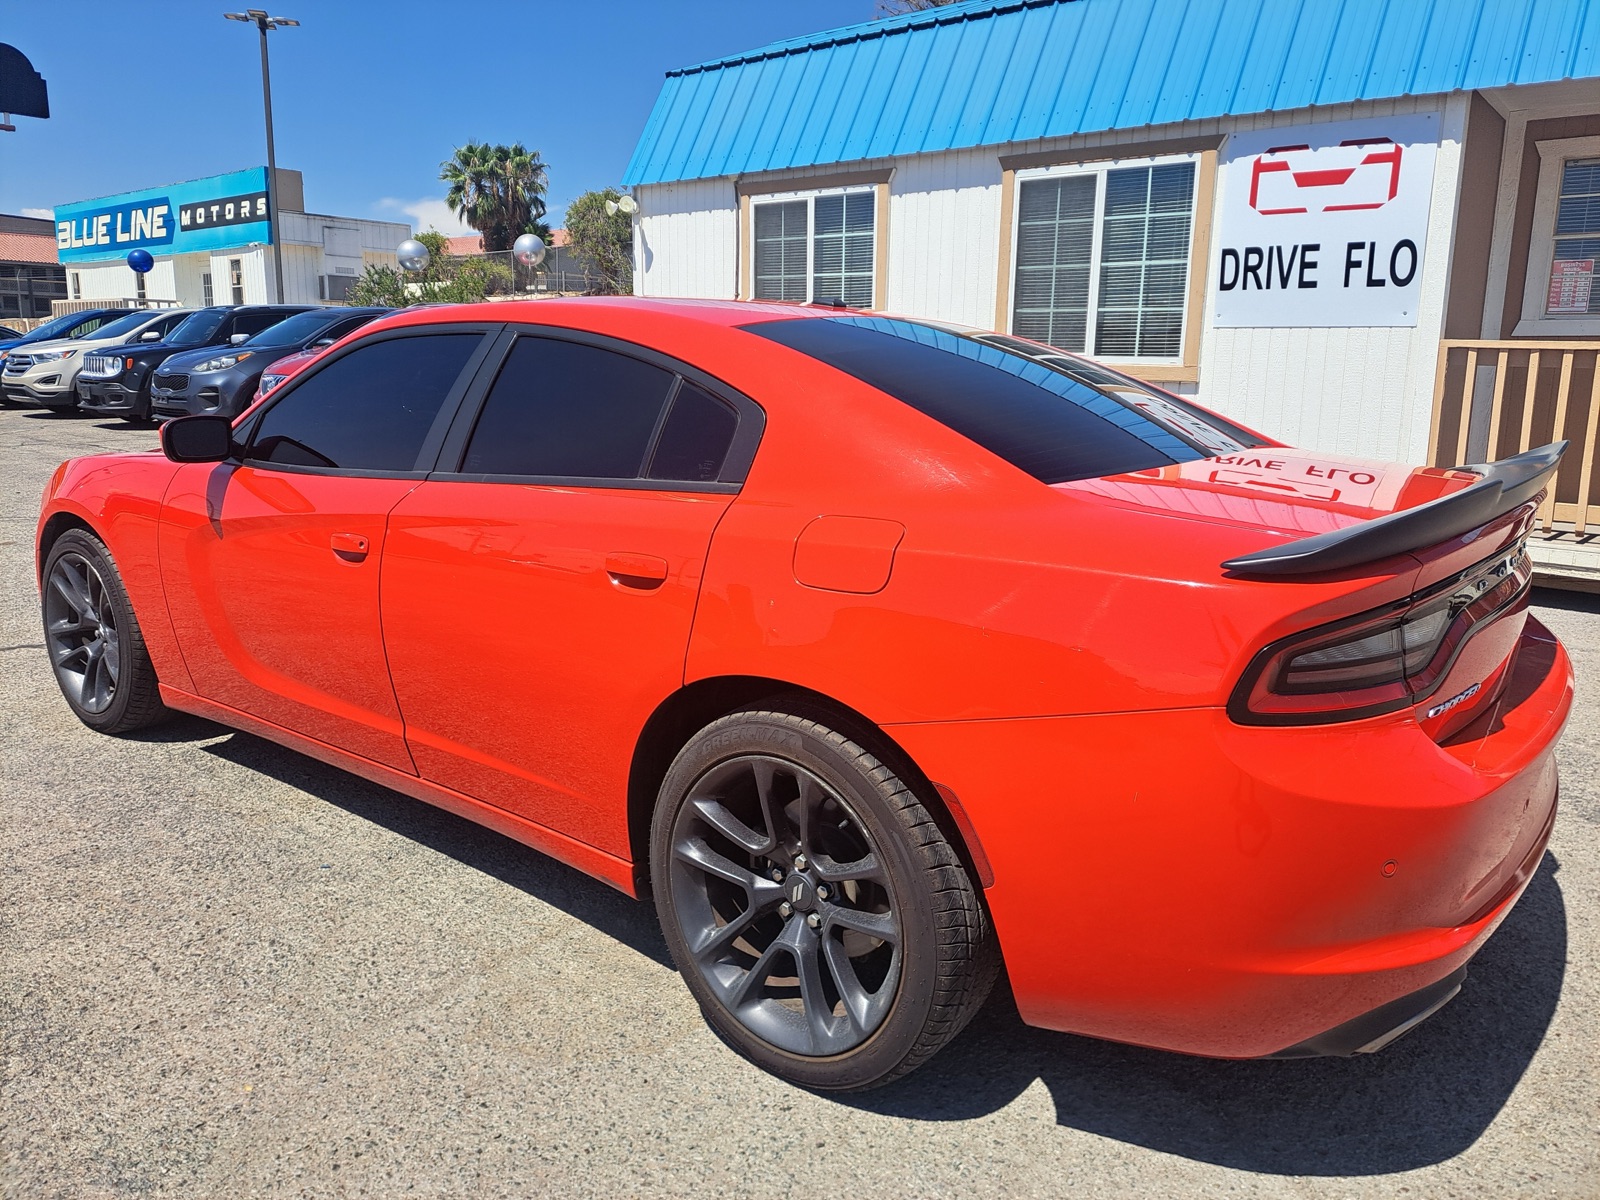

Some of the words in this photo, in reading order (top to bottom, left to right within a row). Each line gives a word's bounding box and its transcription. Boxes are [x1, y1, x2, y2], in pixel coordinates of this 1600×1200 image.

[58, 214, 110, 249] BLUE
[116, 205, 169, 243] LINE
[181, 197, 266, 226] MOTORS
[1219, 243, 1321, 291] DRIVE
[1343, 238, 1418, 288] FLO
